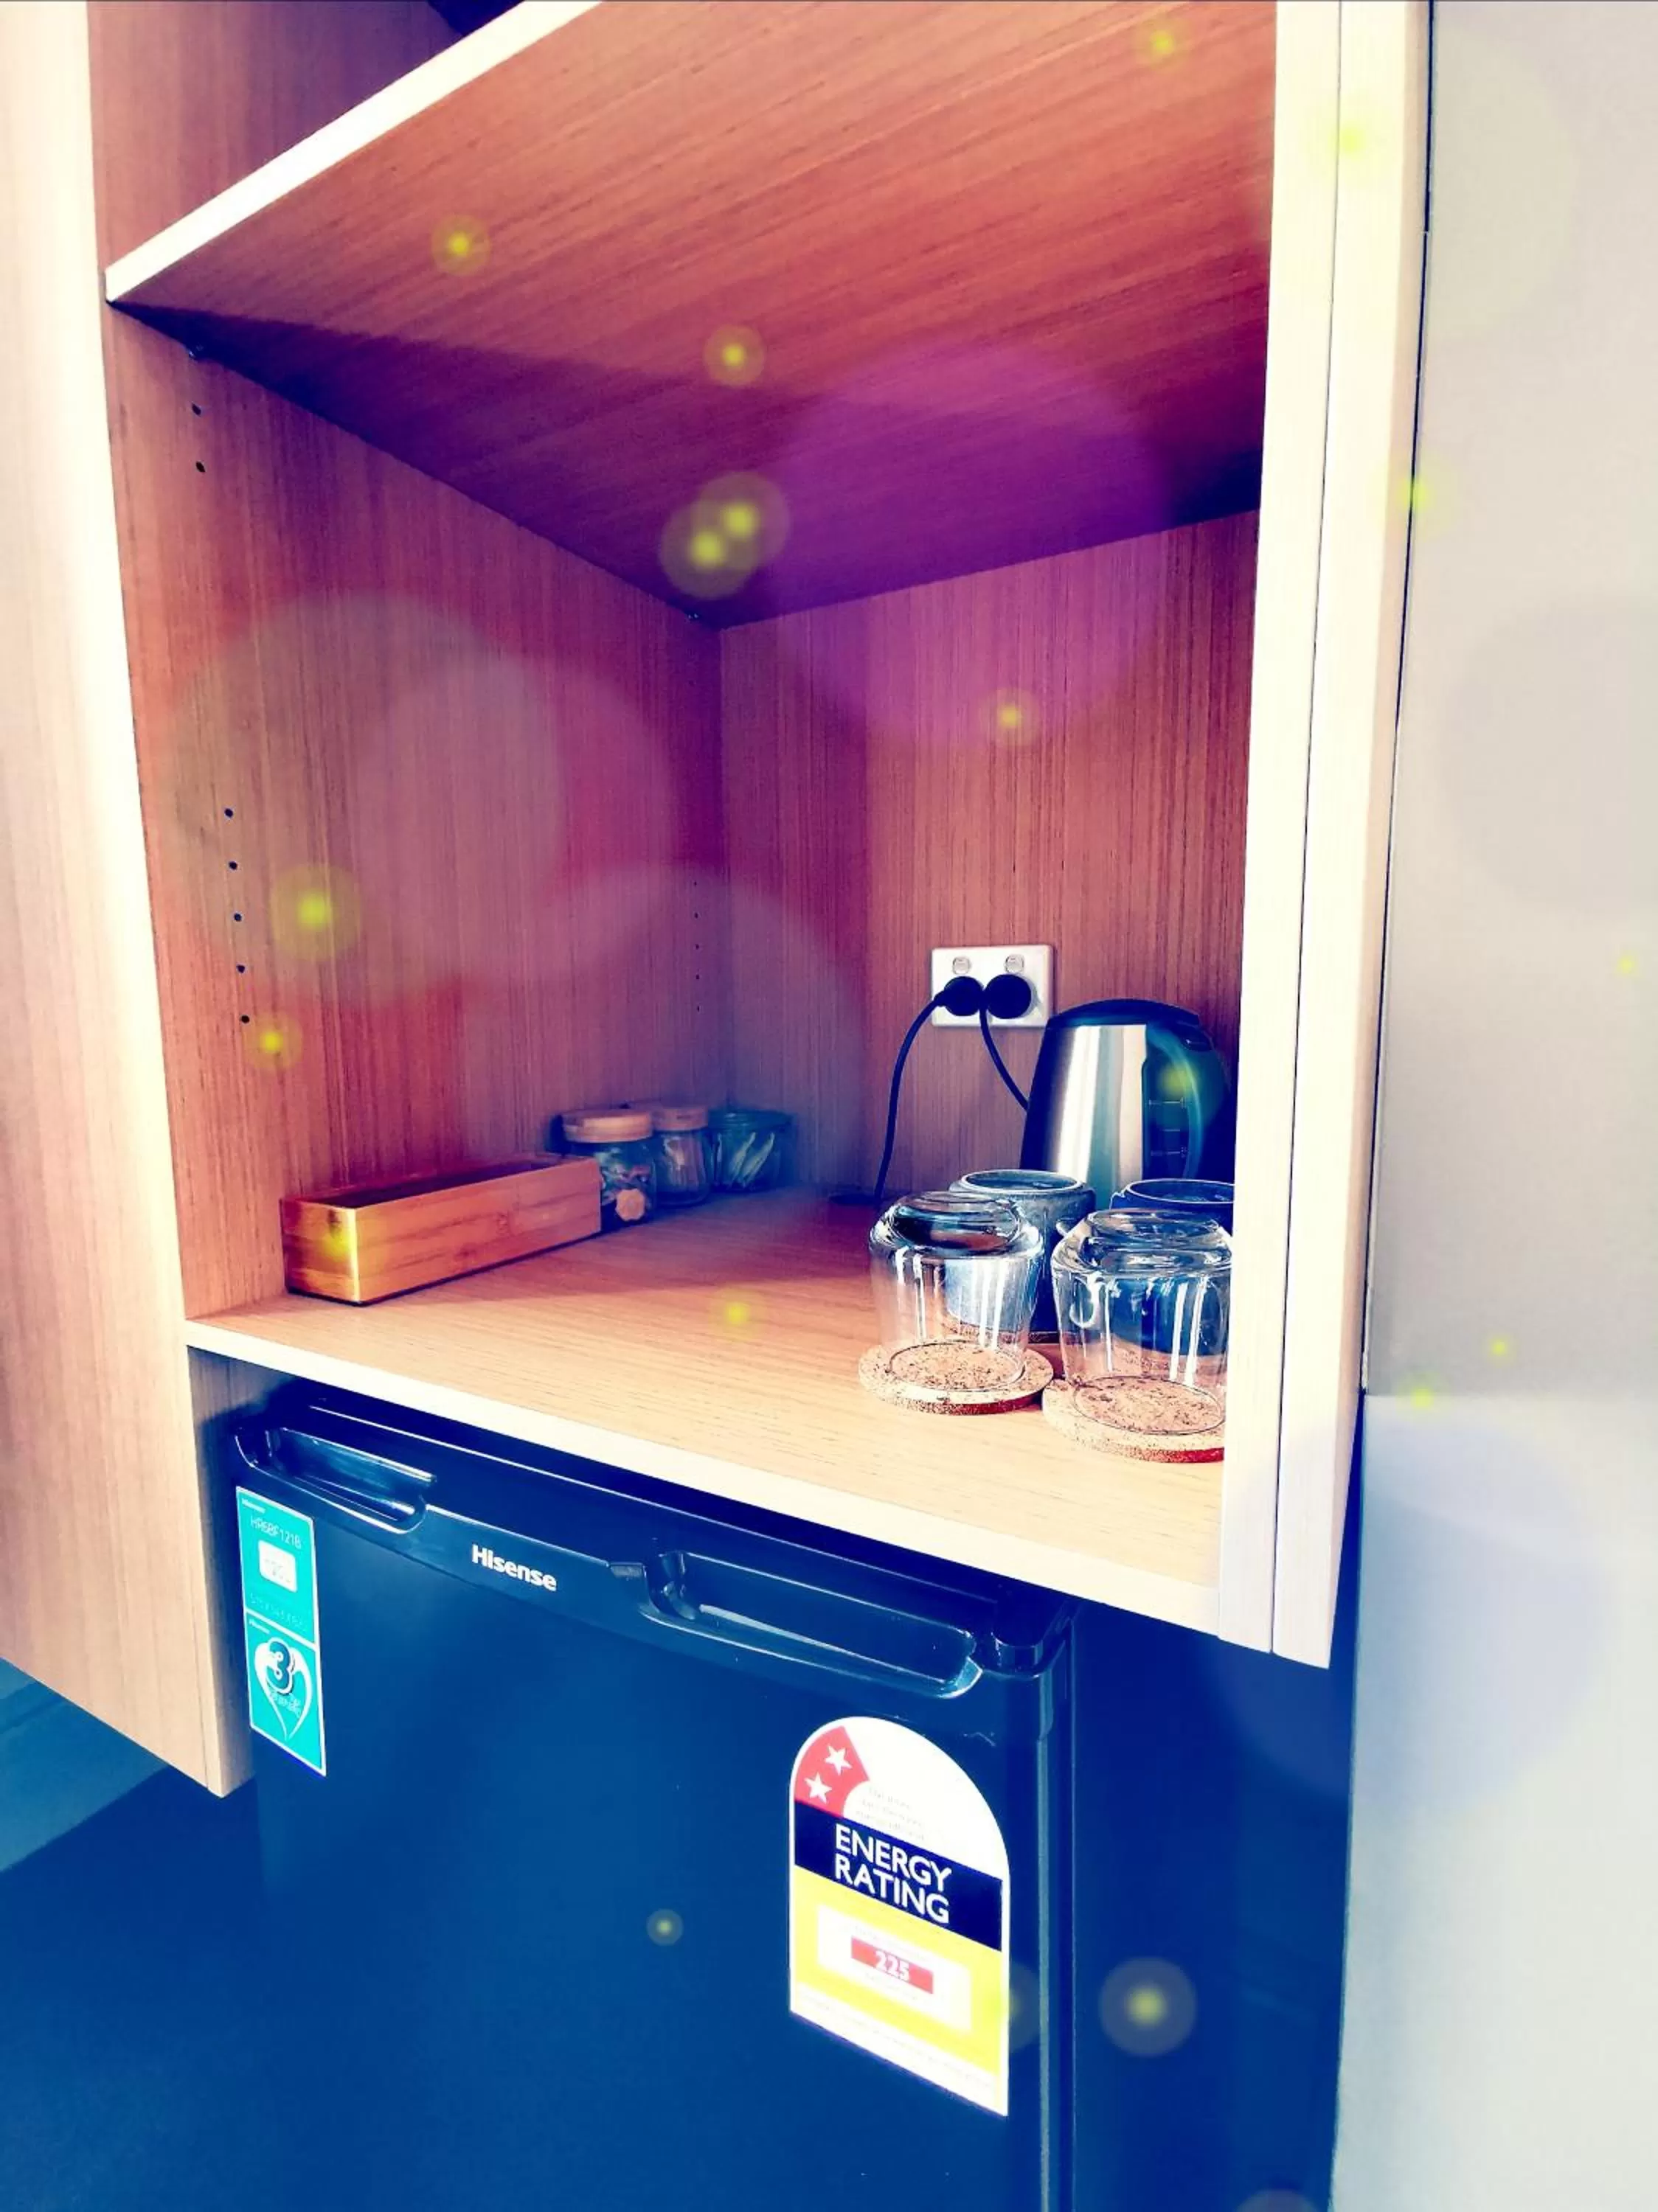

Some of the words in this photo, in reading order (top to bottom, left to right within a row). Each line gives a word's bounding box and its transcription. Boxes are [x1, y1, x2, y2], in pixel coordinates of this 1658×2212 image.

[472, 1543, 557, 1592] Hisense
[266, 1639, 291, 1691] 3
[835, 1823, 951, 1893] ENERGY
[835, 1853, 950, 1924] RATING
[875, 1950, 910, 1982] 225
